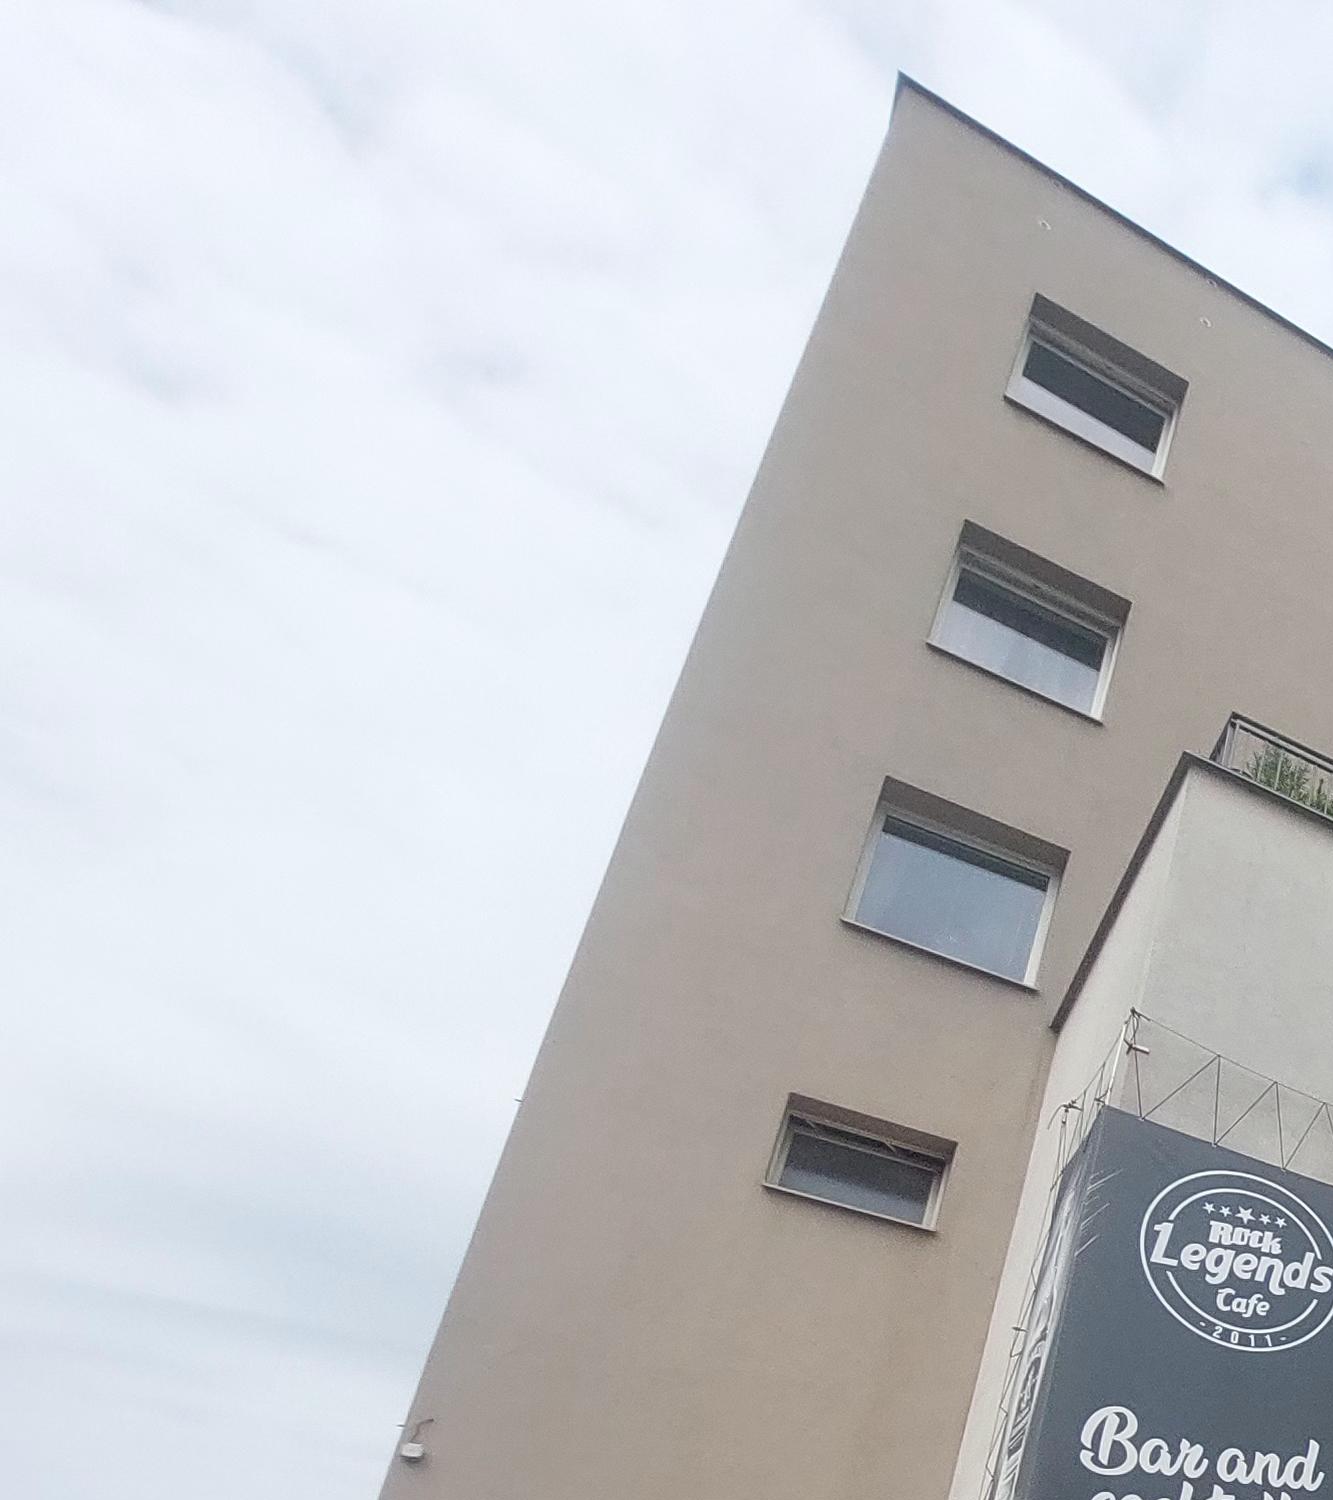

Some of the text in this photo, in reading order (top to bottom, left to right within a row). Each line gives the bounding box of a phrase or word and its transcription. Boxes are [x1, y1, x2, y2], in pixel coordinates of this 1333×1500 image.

[1208, 1221, 1283, 1255] Rock
[1215, 1287, 1271, 1318] Cafe
[1079, 1405, 1325, 1492] Bar and
